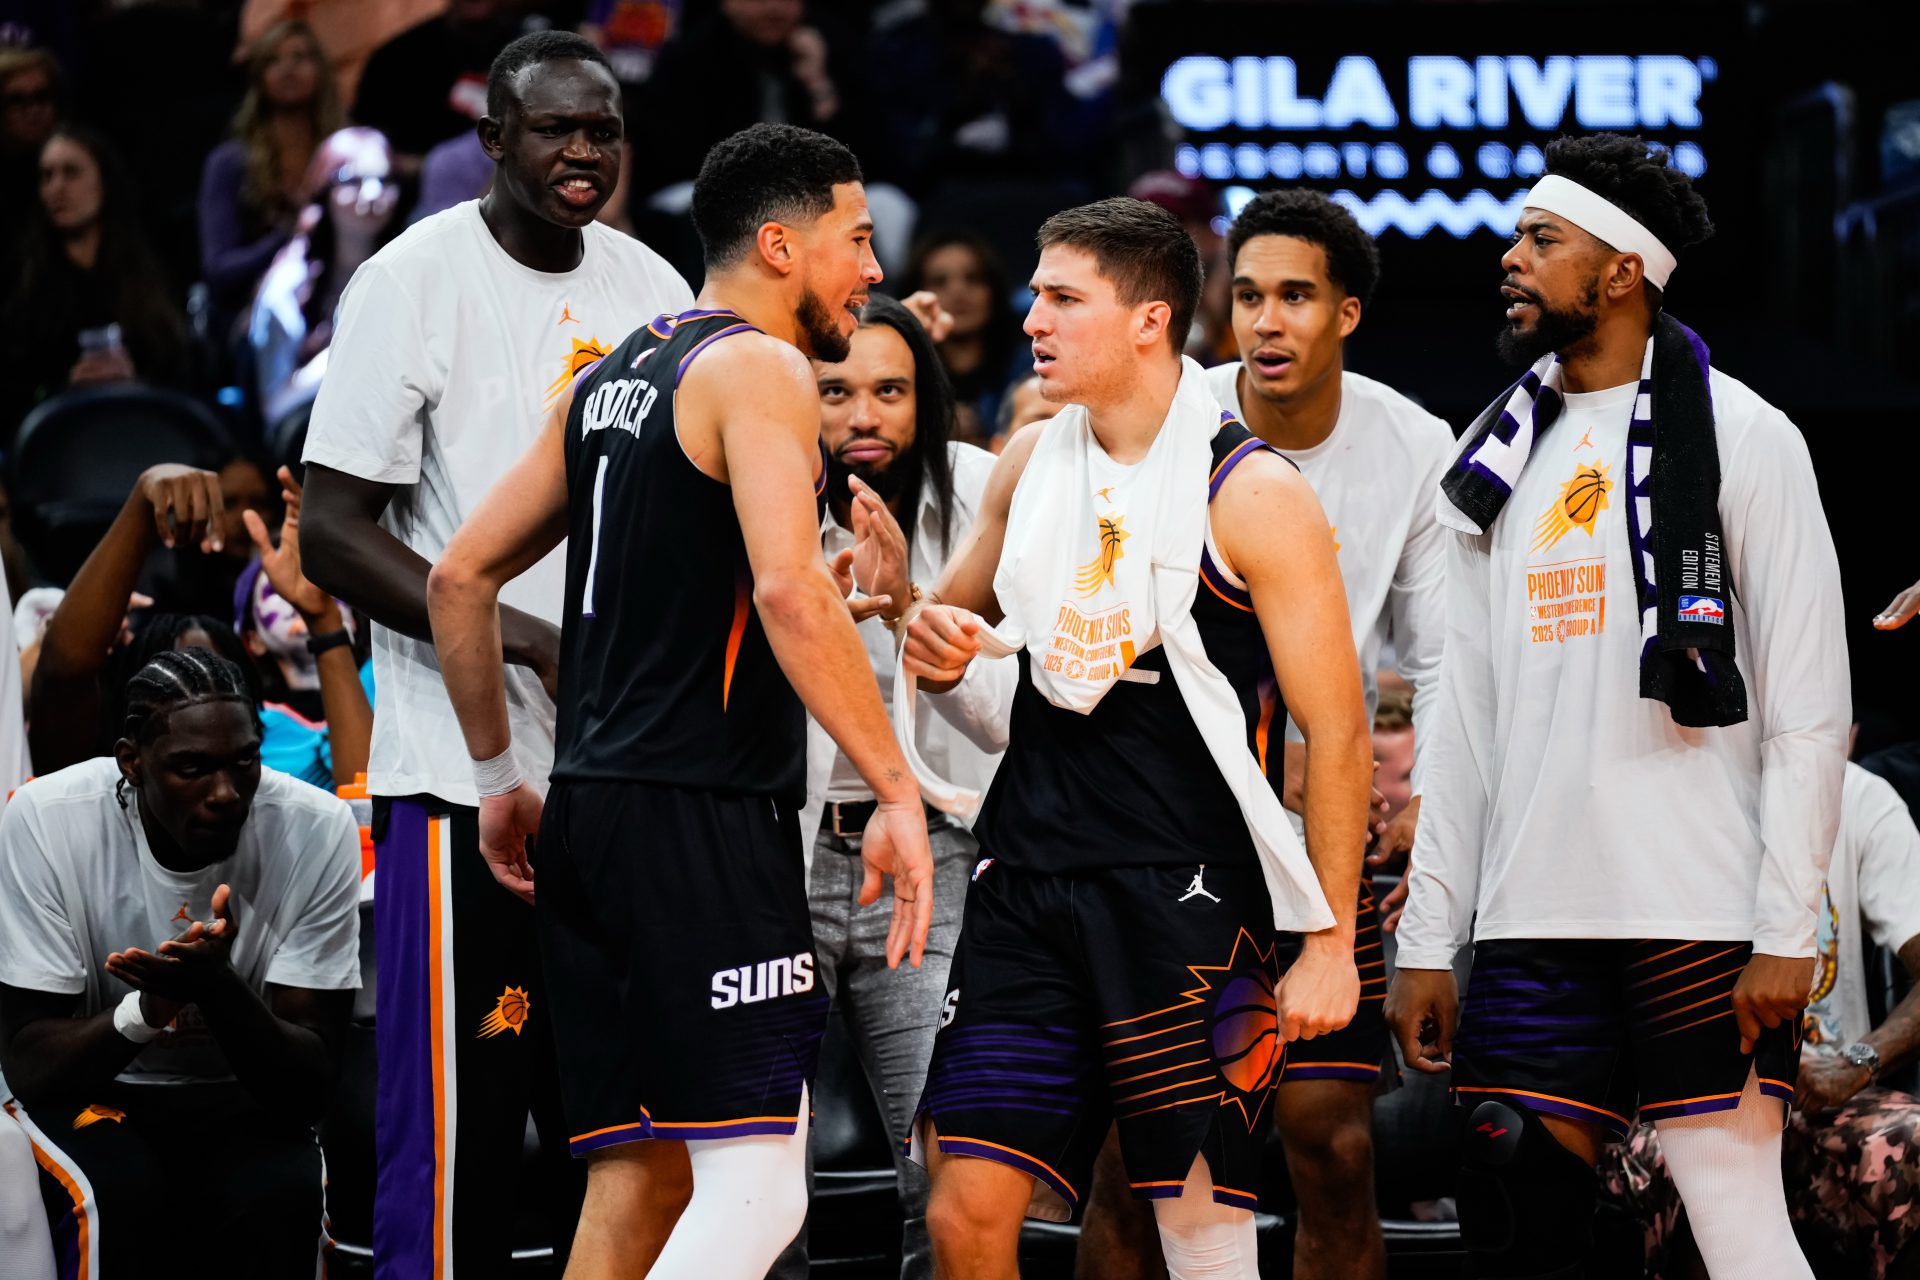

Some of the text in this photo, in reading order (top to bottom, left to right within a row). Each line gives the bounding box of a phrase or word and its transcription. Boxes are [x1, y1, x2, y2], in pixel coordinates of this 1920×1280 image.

[1161, 55, 1703, 130] GILA RIVER
[582, 378, 659, 441] BOOKER
[582, 455, 609, 618] 1
[1682, 549, 1699, 589] EDITION
[1705, 532, 1720, 593] STATEMENT
[1527, 567, 1576, 601] PHOENIX
[1053, 606, 1132, 645] PHOENIX SUNS
[1531, 624, 1554, 643] 2025
[1591, 618, 1596, 636] A
[1043, 653, 1065, 673] 2025
[1087, 663, 1110, 681] GROUP
[1112, 661, 1120, 678] A
[1054, 636, 1085, 659] WESTERN
